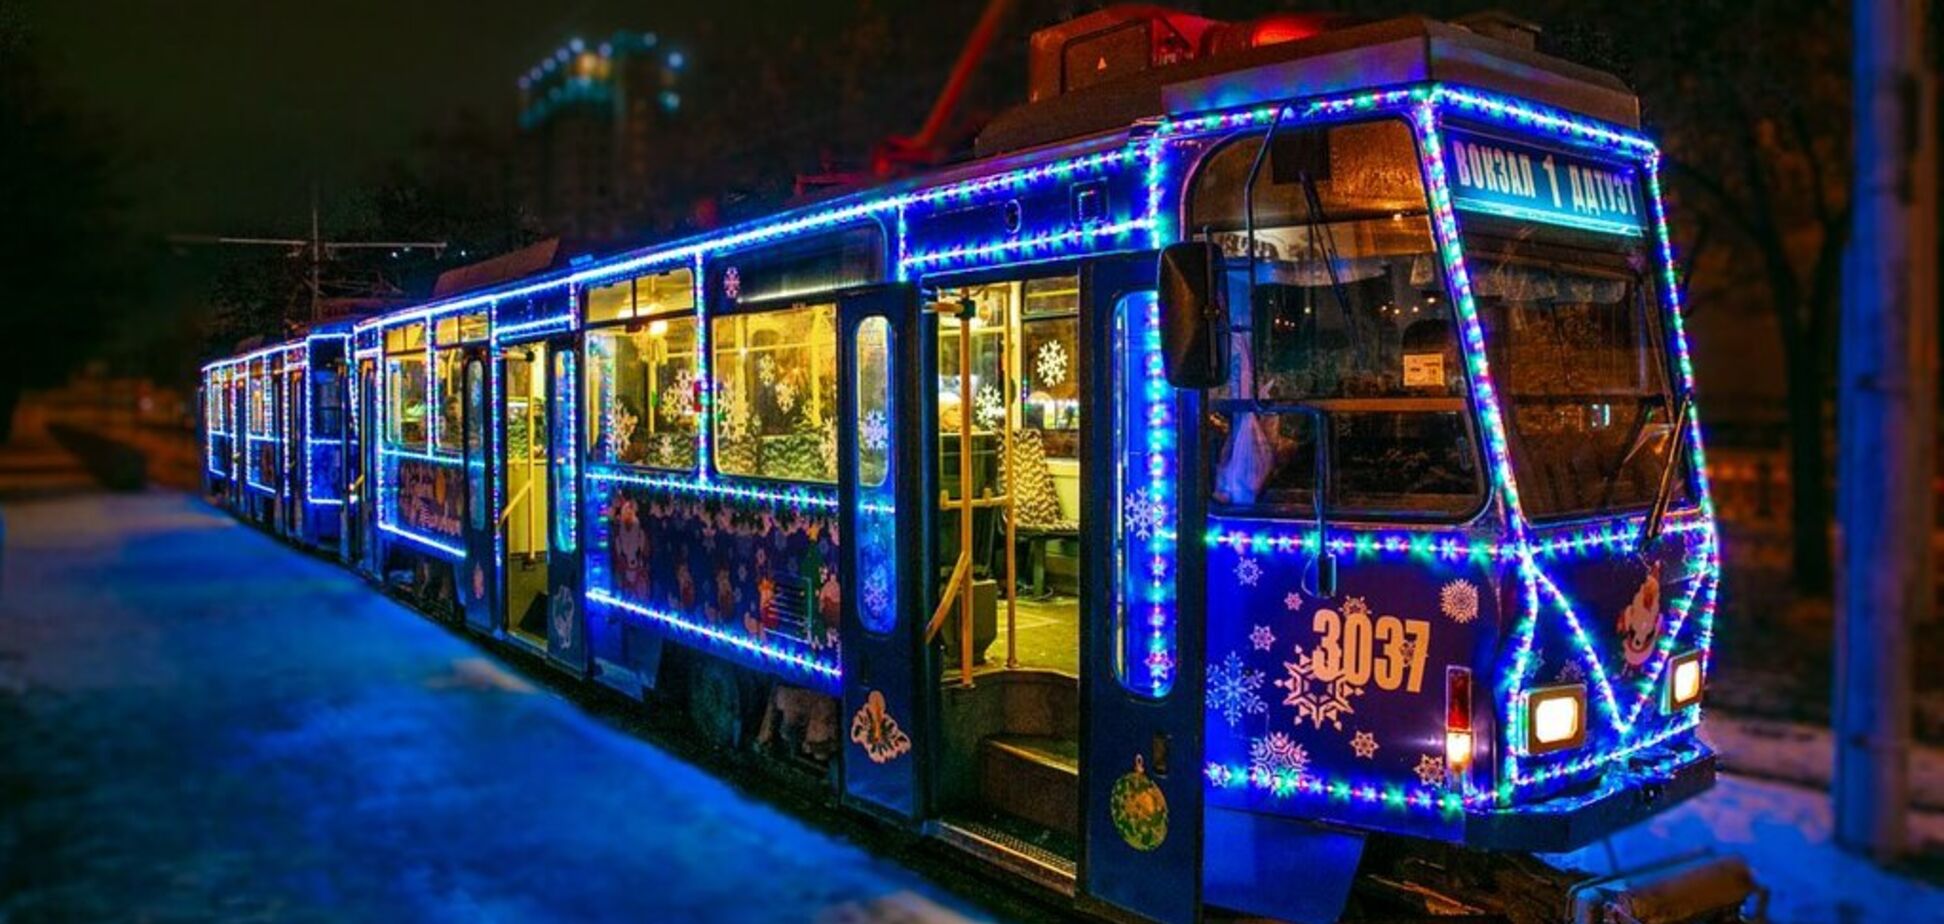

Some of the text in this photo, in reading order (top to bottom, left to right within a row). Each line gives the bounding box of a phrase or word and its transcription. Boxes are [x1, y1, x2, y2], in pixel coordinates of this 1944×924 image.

[1452, 140, 1537, 198] ВОКЗАЛ
[1542, 154, 1563, 208] 1
[1312, 608, 1431, 694] 3037
